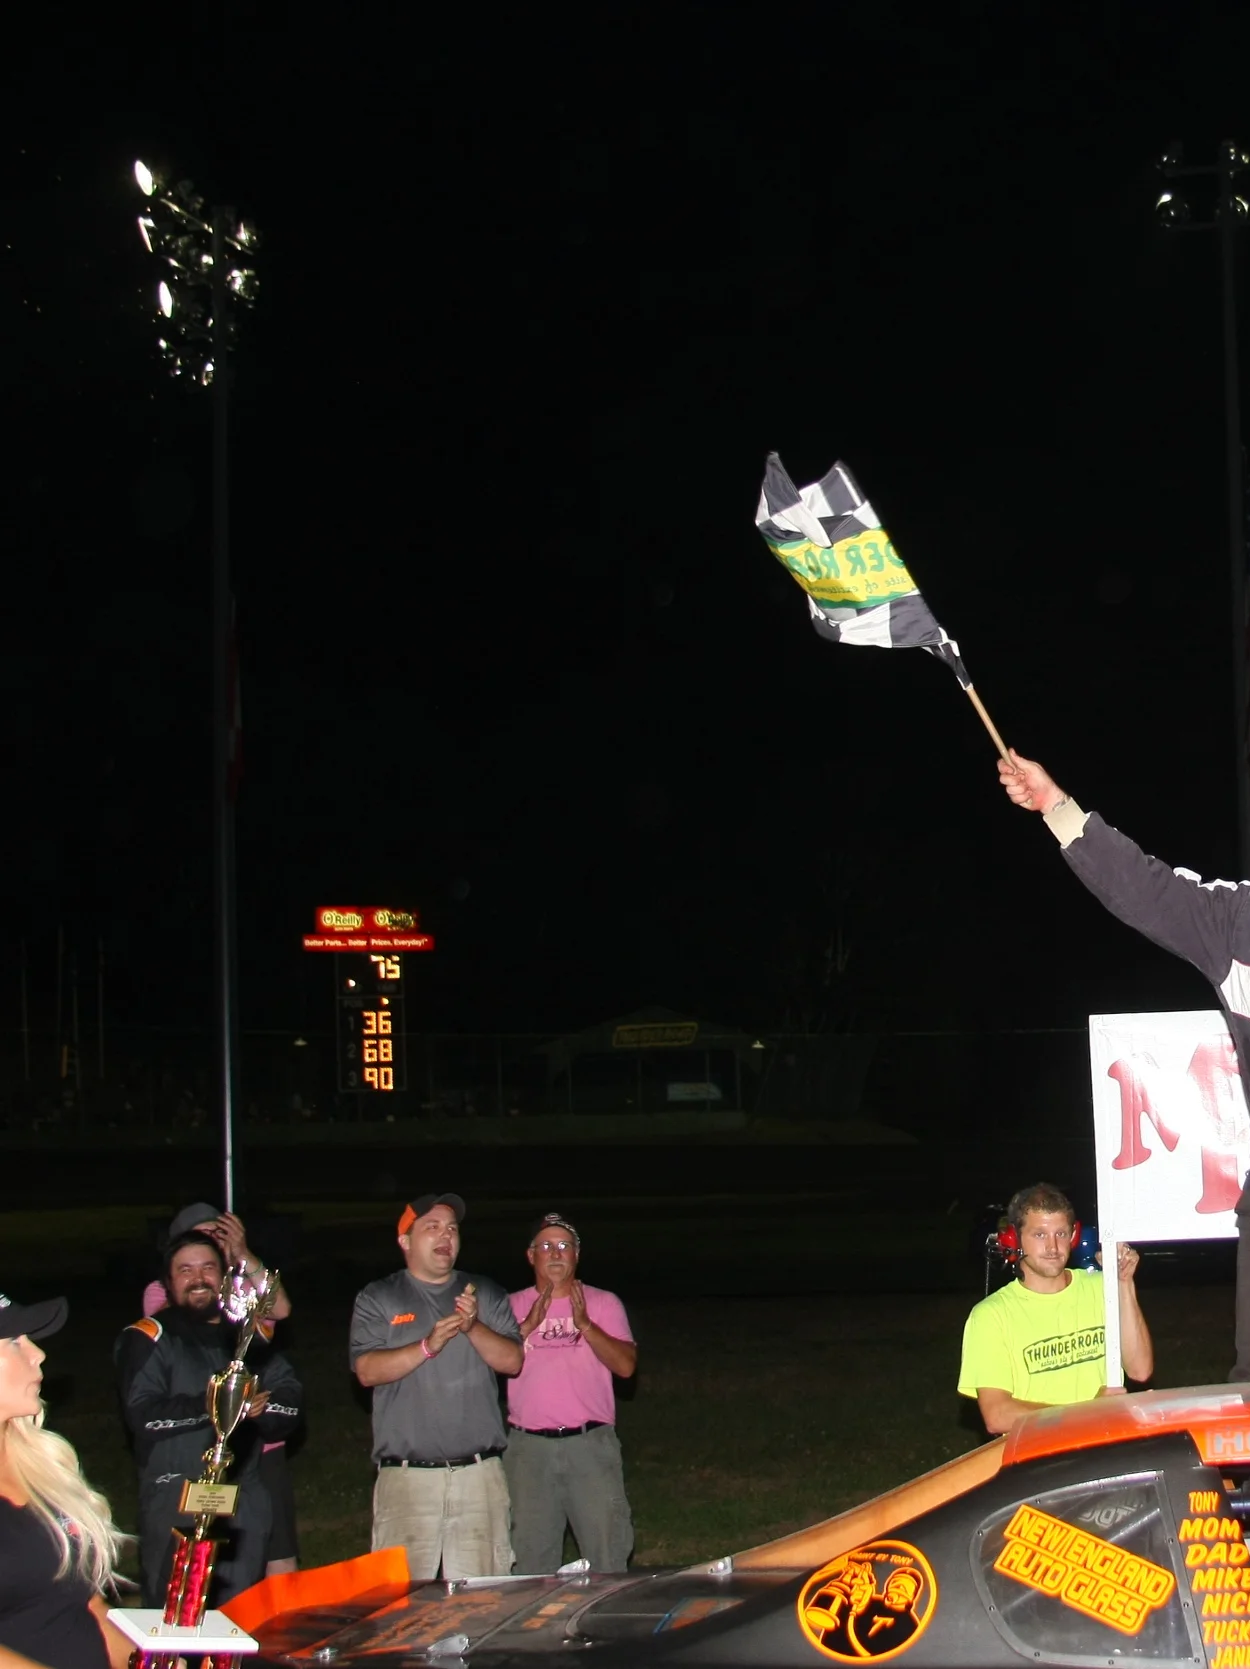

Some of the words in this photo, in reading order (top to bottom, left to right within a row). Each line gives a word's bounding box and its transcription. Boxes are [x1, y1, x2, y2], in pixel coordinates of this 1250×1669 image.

[322, 909, 362, 928] O'Reilly
[370, 954, 400, 979] 75
[362, 1011, 392, 1035] 36
[363, 1039, 393, 1063] 68
[364, 1067, 394, 1090] 90
[1188, 1491, 1219, 1513] TONY
[1178, 1517, 1241, 1542] MOM
[1011, 1511, 1068, 1552] NEW
[1064, 1533, 1169, 1601] ENGLAND
[1185, 1542, 1250, 1568] DAD
[1001, 1545, 1068, 1590] AUTO
[1066, 1575, 1143, 1626] GLASS
